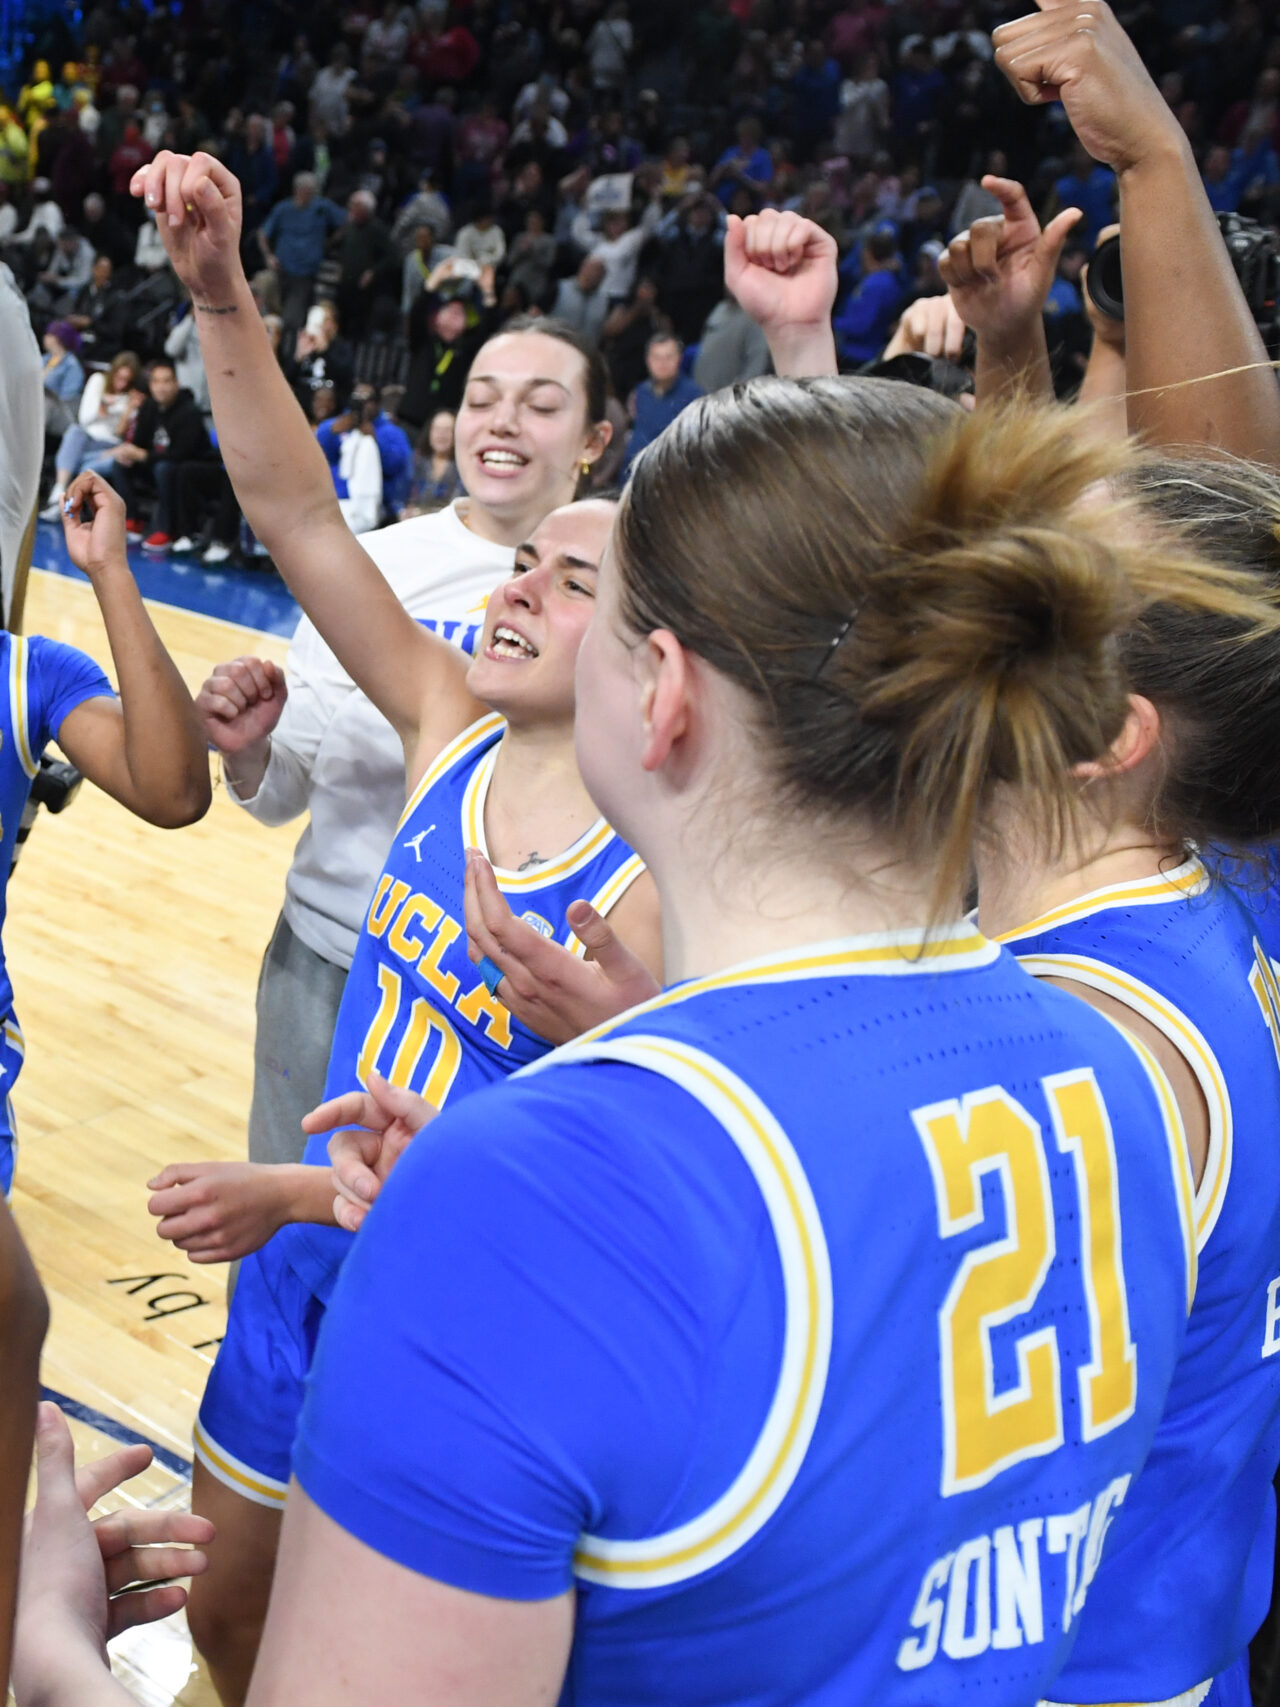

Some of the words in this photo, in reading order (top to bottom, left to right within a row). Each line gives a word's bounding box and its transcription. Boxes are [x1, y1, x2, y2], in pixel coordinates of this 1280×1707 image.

[356, 962, 463, 1112] 10
[367, 872, 514, 1051] UCLA
[106, 1272, 211, 1322] by
[910, 1066, 1137, 1498] 21
